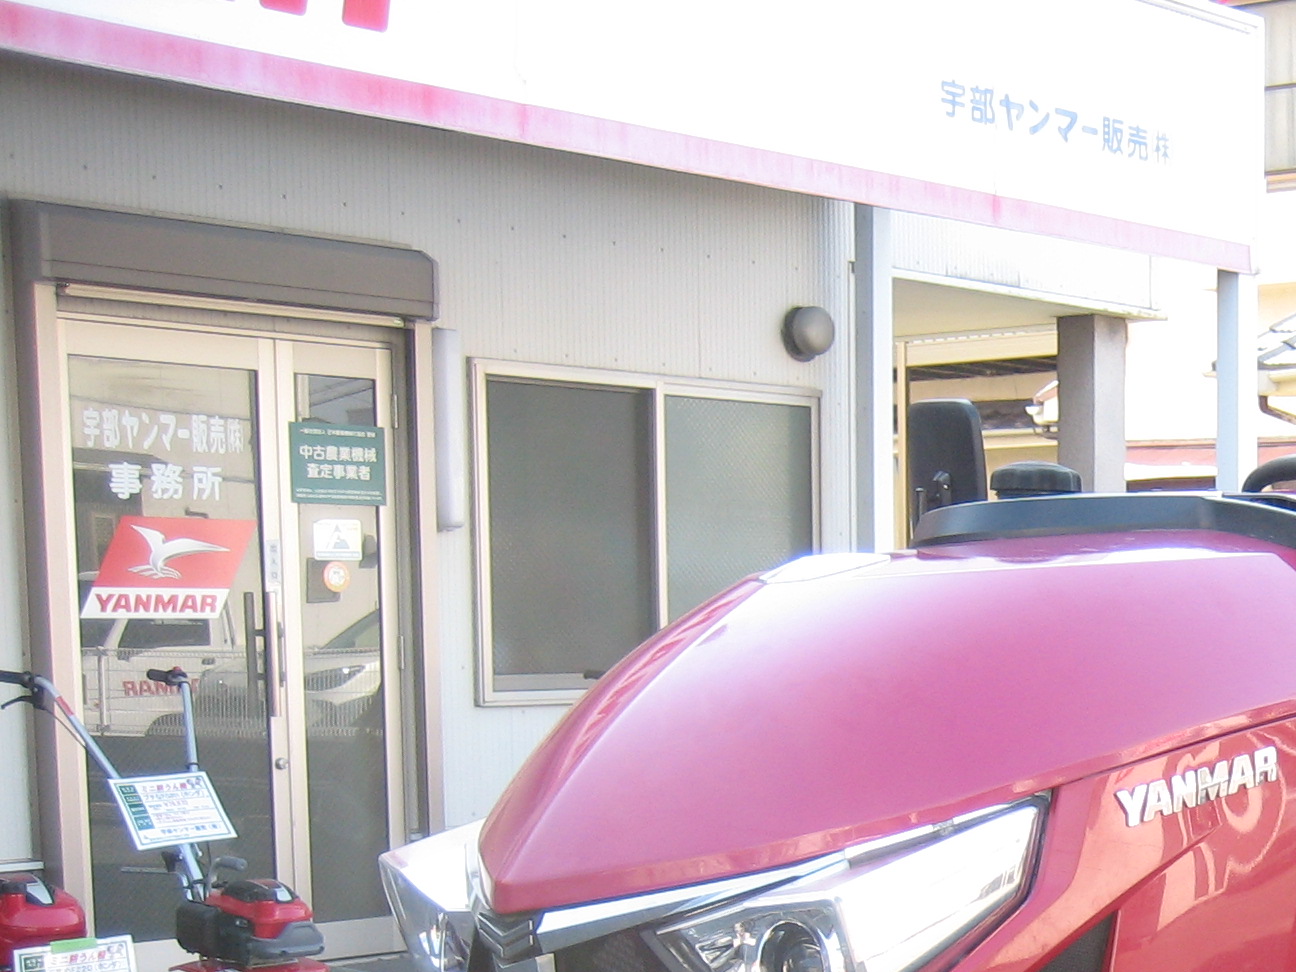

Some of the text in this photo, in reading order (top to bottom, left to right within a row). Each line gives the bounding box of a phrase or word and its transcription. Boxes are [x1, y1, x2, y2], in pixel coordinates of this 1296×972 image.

[108, 462, 223, 501] 事務所
[95, 593, 218, 613] YANMAR
[1114, 746, 1278, 828] YANMAR
